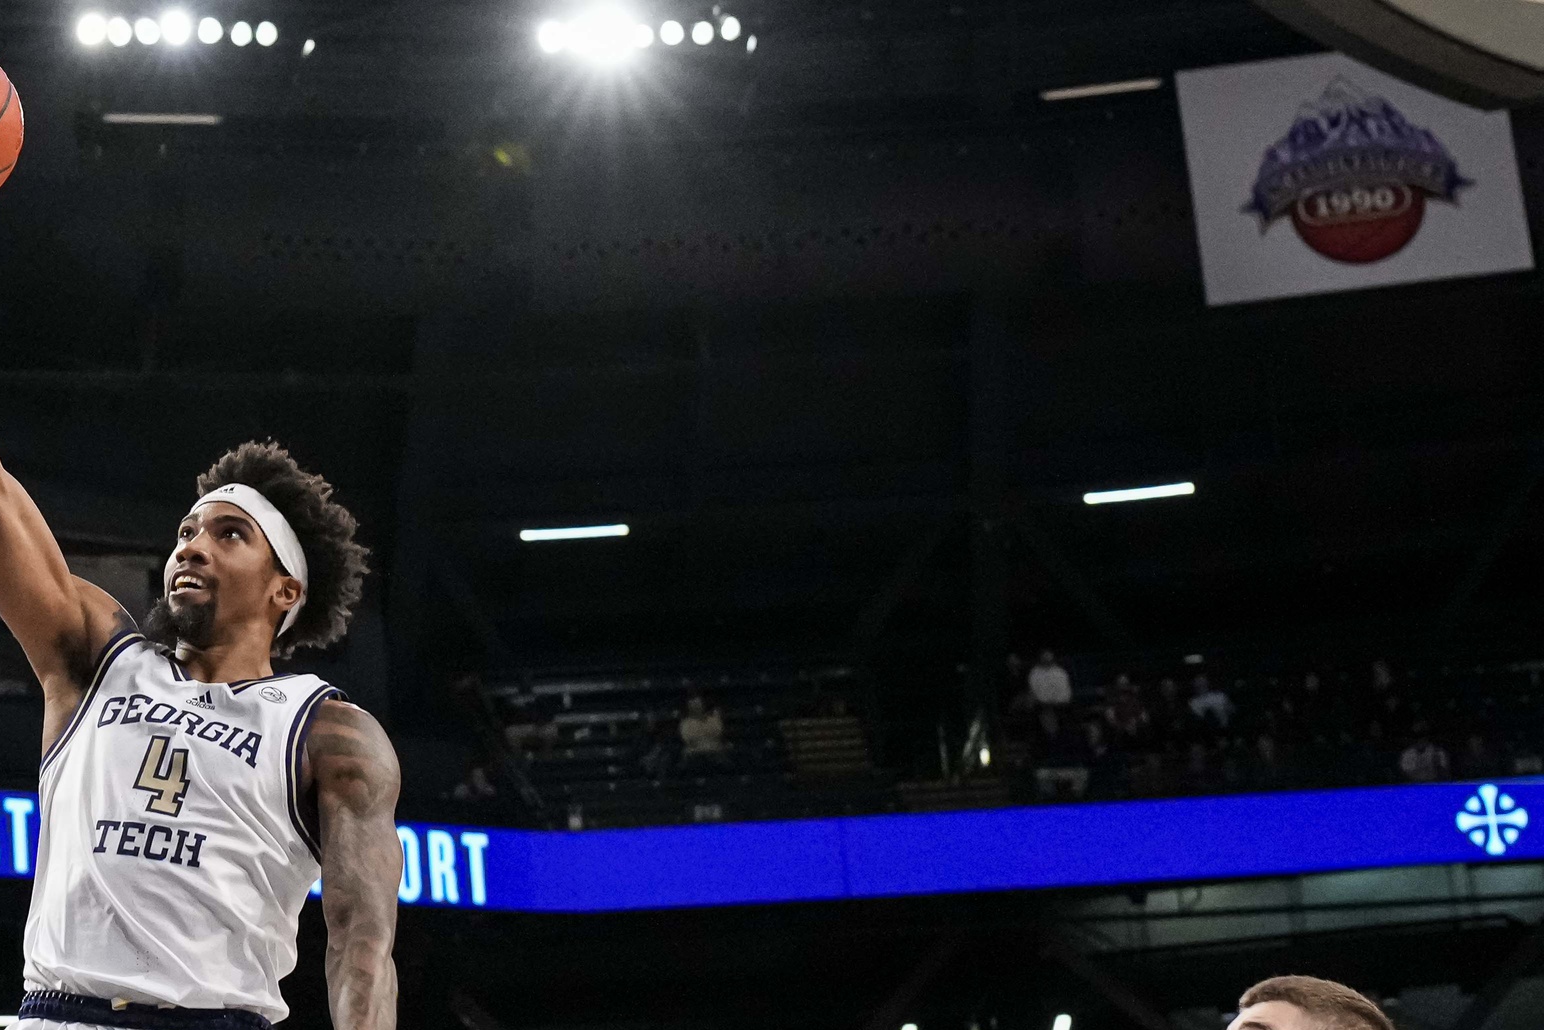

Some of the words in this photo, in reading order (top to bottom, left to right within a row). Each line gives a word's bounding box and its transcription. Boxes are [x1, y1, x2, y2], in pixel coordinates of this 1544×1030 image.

[1315, 187, 1395, 218] 1990
[97, 694, 262, 769] GEORGIA
[186, 698, 216, 711] adidas
[133, 735, 191, 817] 4
[93, 820, 207, 868] TECH
[397, 826, 490, 906] ORT
